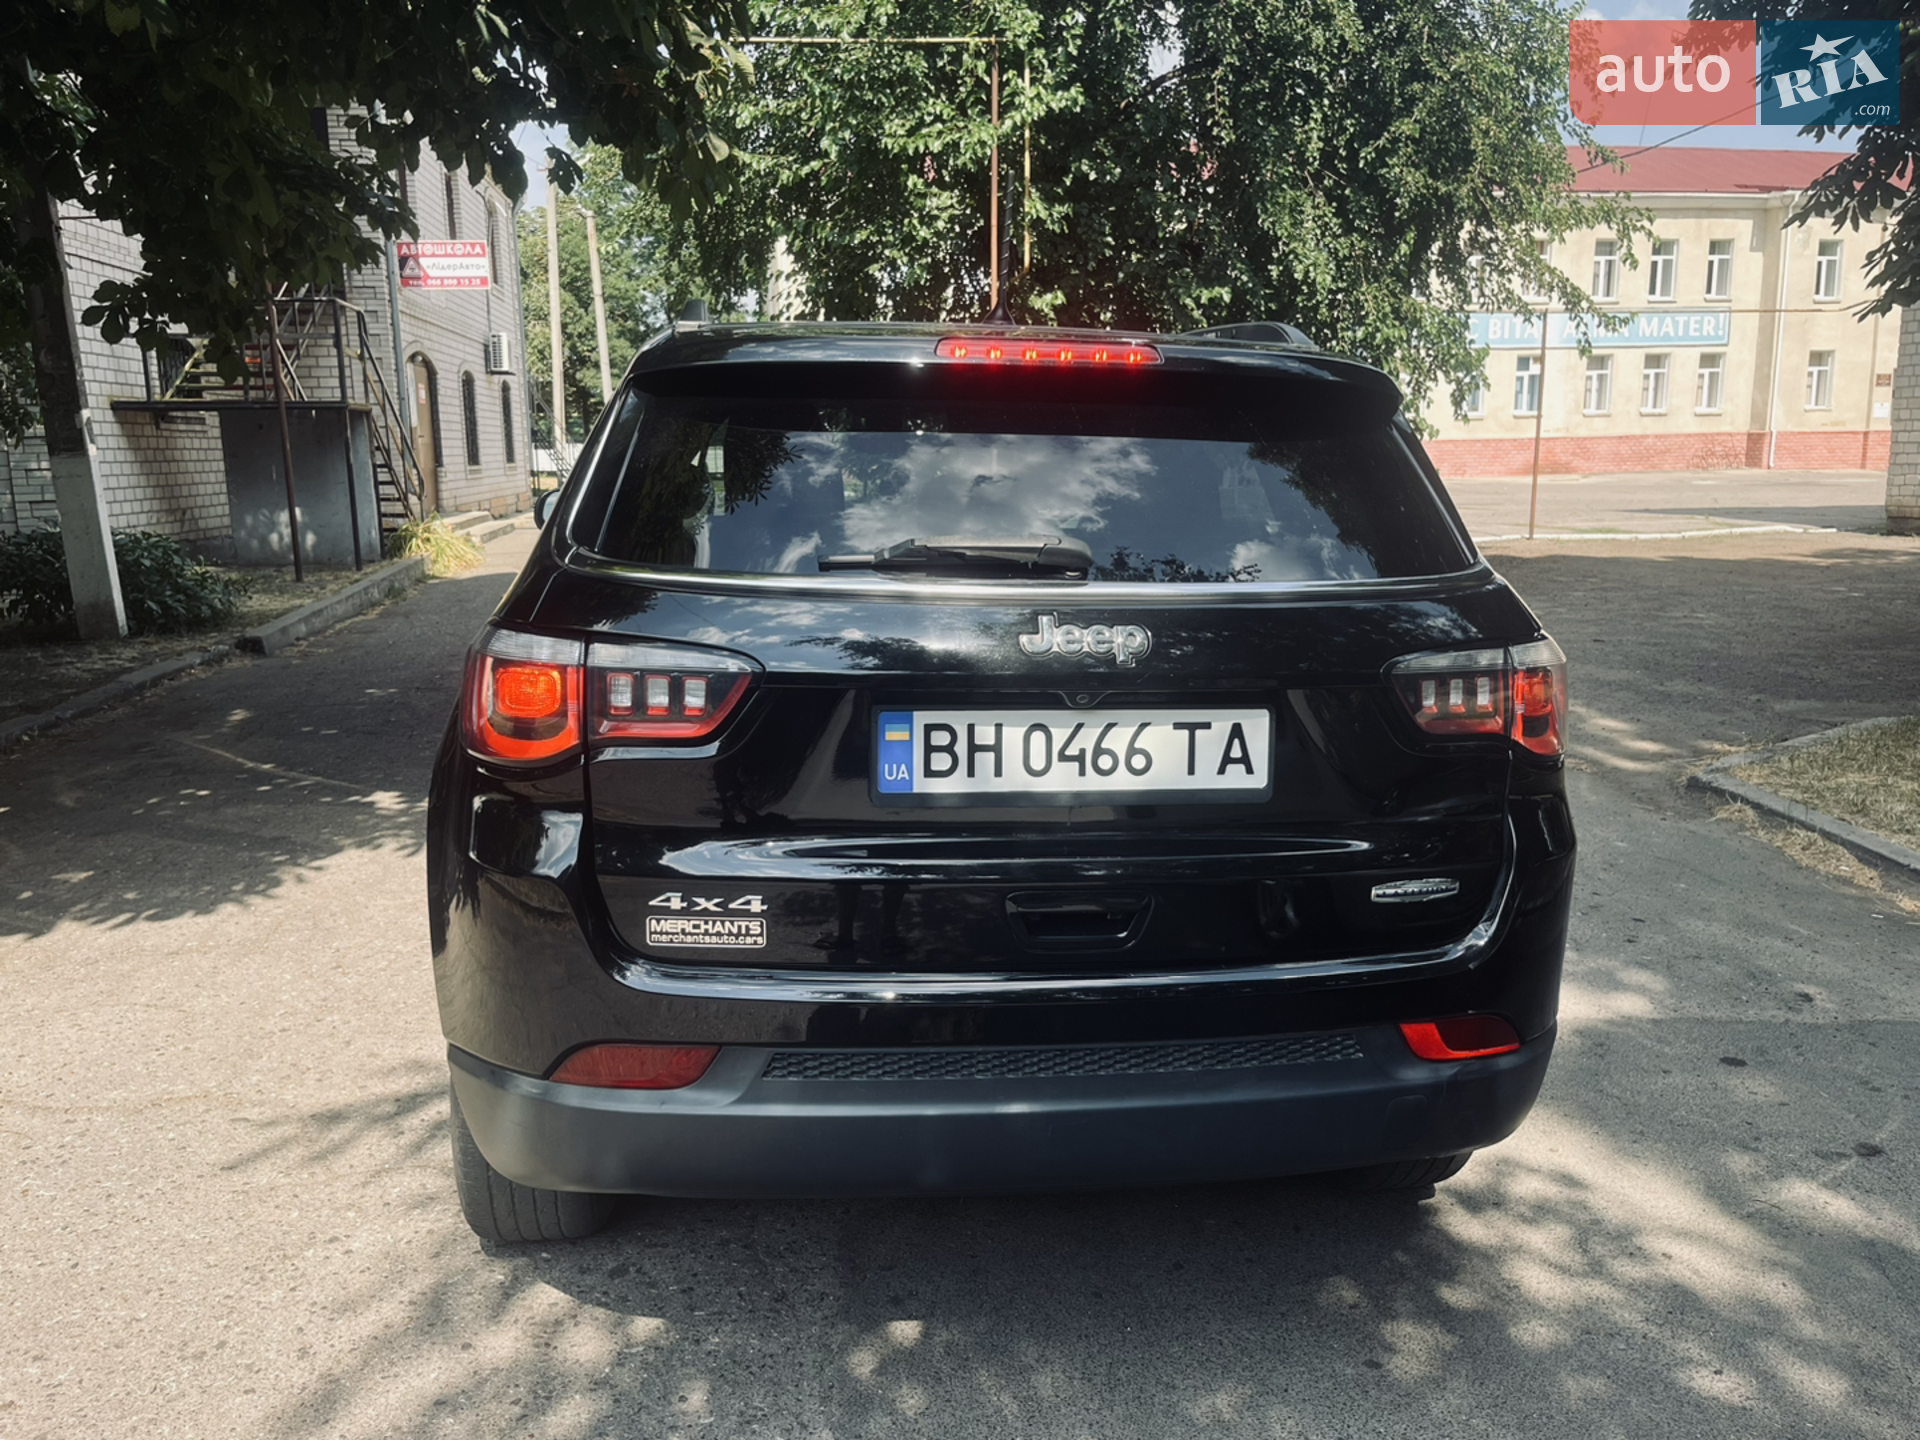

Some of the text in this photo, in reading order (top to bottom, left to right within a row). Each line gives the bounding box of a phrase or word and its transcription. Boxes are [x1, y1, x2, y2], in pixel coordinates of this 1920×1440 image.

[400, 243, 484, 255] АВТОШКОЛА
[1638, 312, 1725, 337] MATER!
[1019, 614, 1152, 665] Jeep
[884, 721, 1255, 780] UA BH 0466 TA
[650, 918, 762, 935] MERCHANTS
[650, 933, 764, 945] merchantsauto.cars
